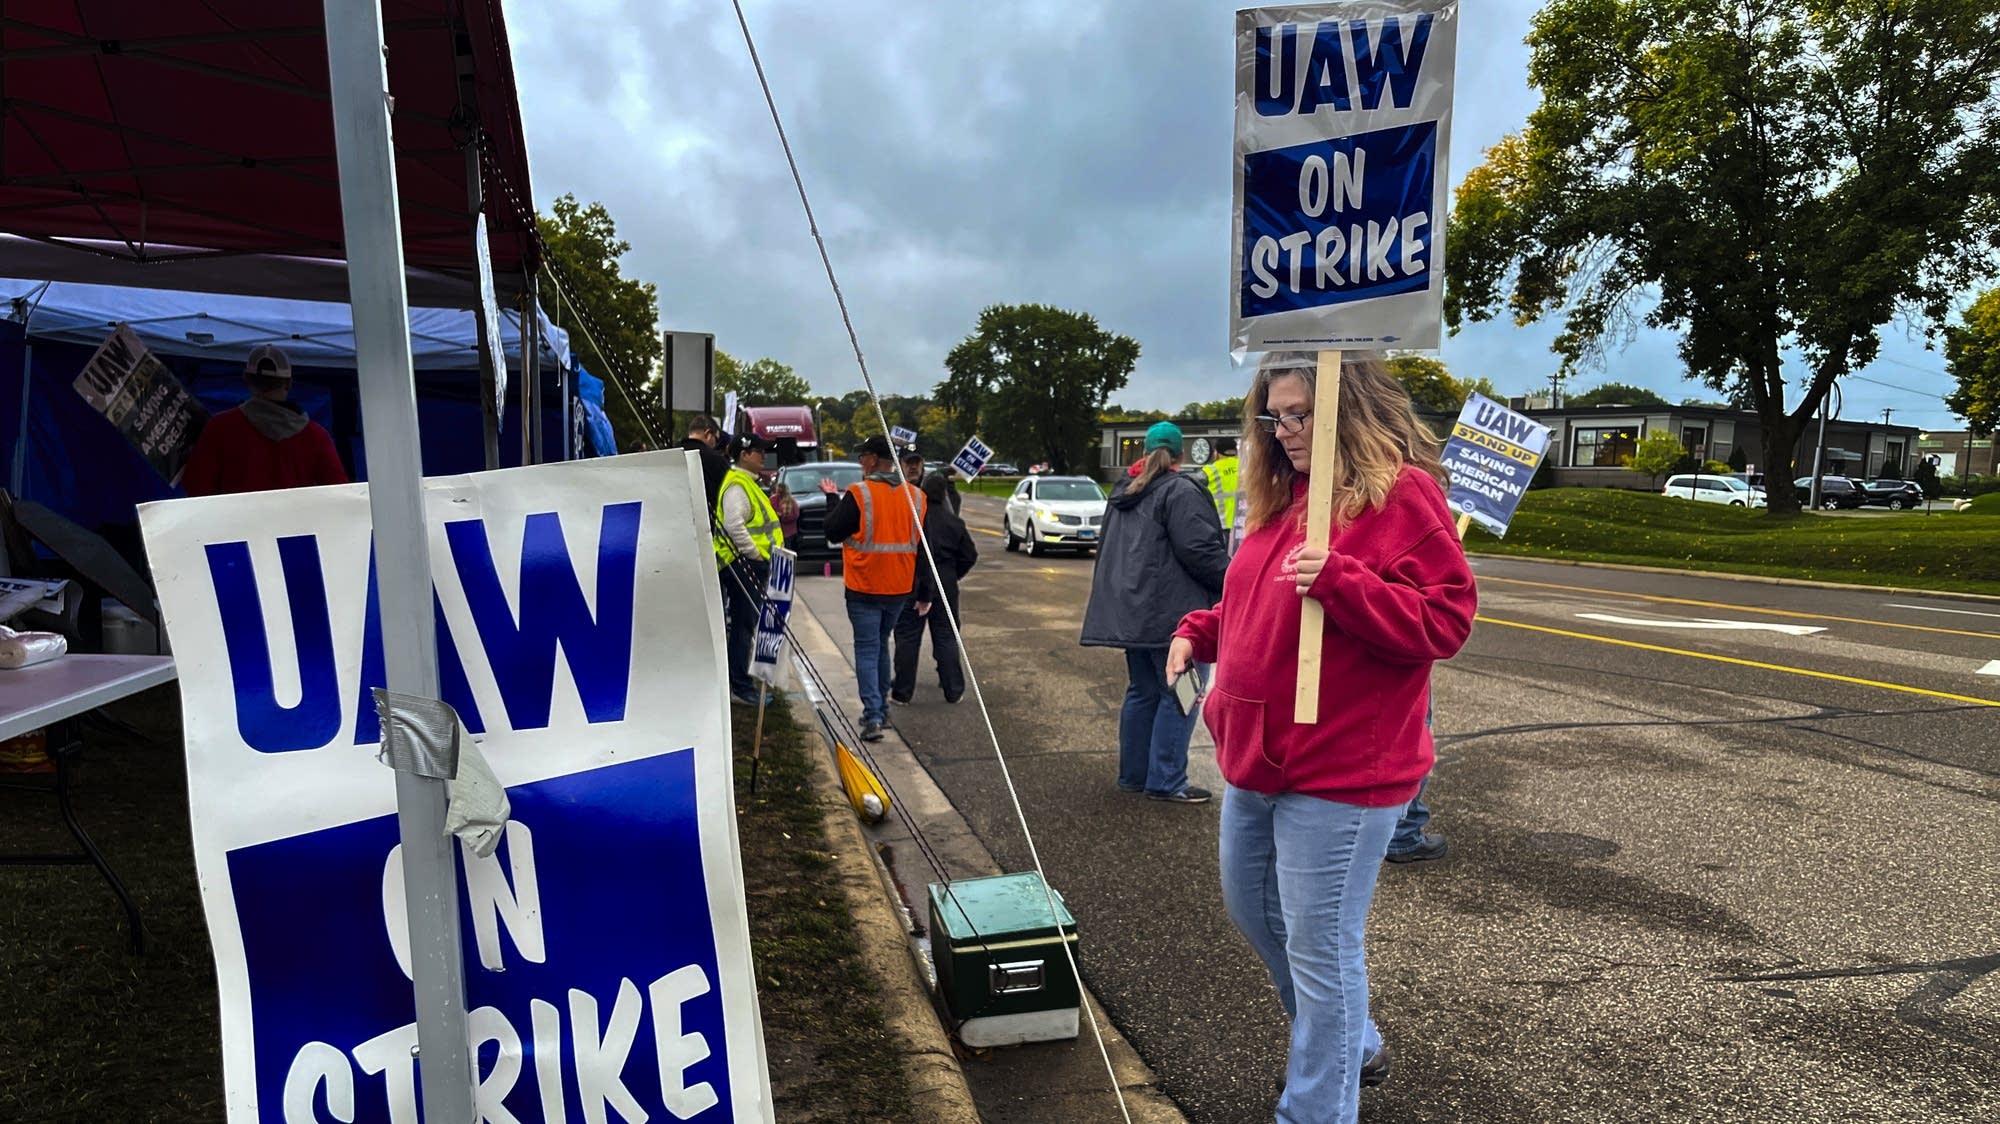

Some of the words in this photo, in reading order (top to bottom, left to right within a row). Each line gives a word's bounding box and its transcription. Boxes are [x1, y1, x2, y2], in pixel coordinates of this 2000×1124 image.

[1254, 13, 1434, 117] UAW
[1299, 147, 1366, 218] ON
[1250, 211, 1428, 299] STRIKE
[83, 334, 137, 396] UAW
[134, 383, 169, 431] SAVING
[141, 389, 190, 456] AMERICAN
[1475, 402, 1537, 444] UAW
[158, 409, 193, 455] DREAM
[968, 438, 991, 459] UAW
[1458, 427, 1509, 453] STAND
[1511, 449, 1533, 462] UP
[1441, 457, 1521, 497] AMERICAN
[1459, 447, 1517, 477] SAVING
[1450, 472, 1505, 502] DREAM
